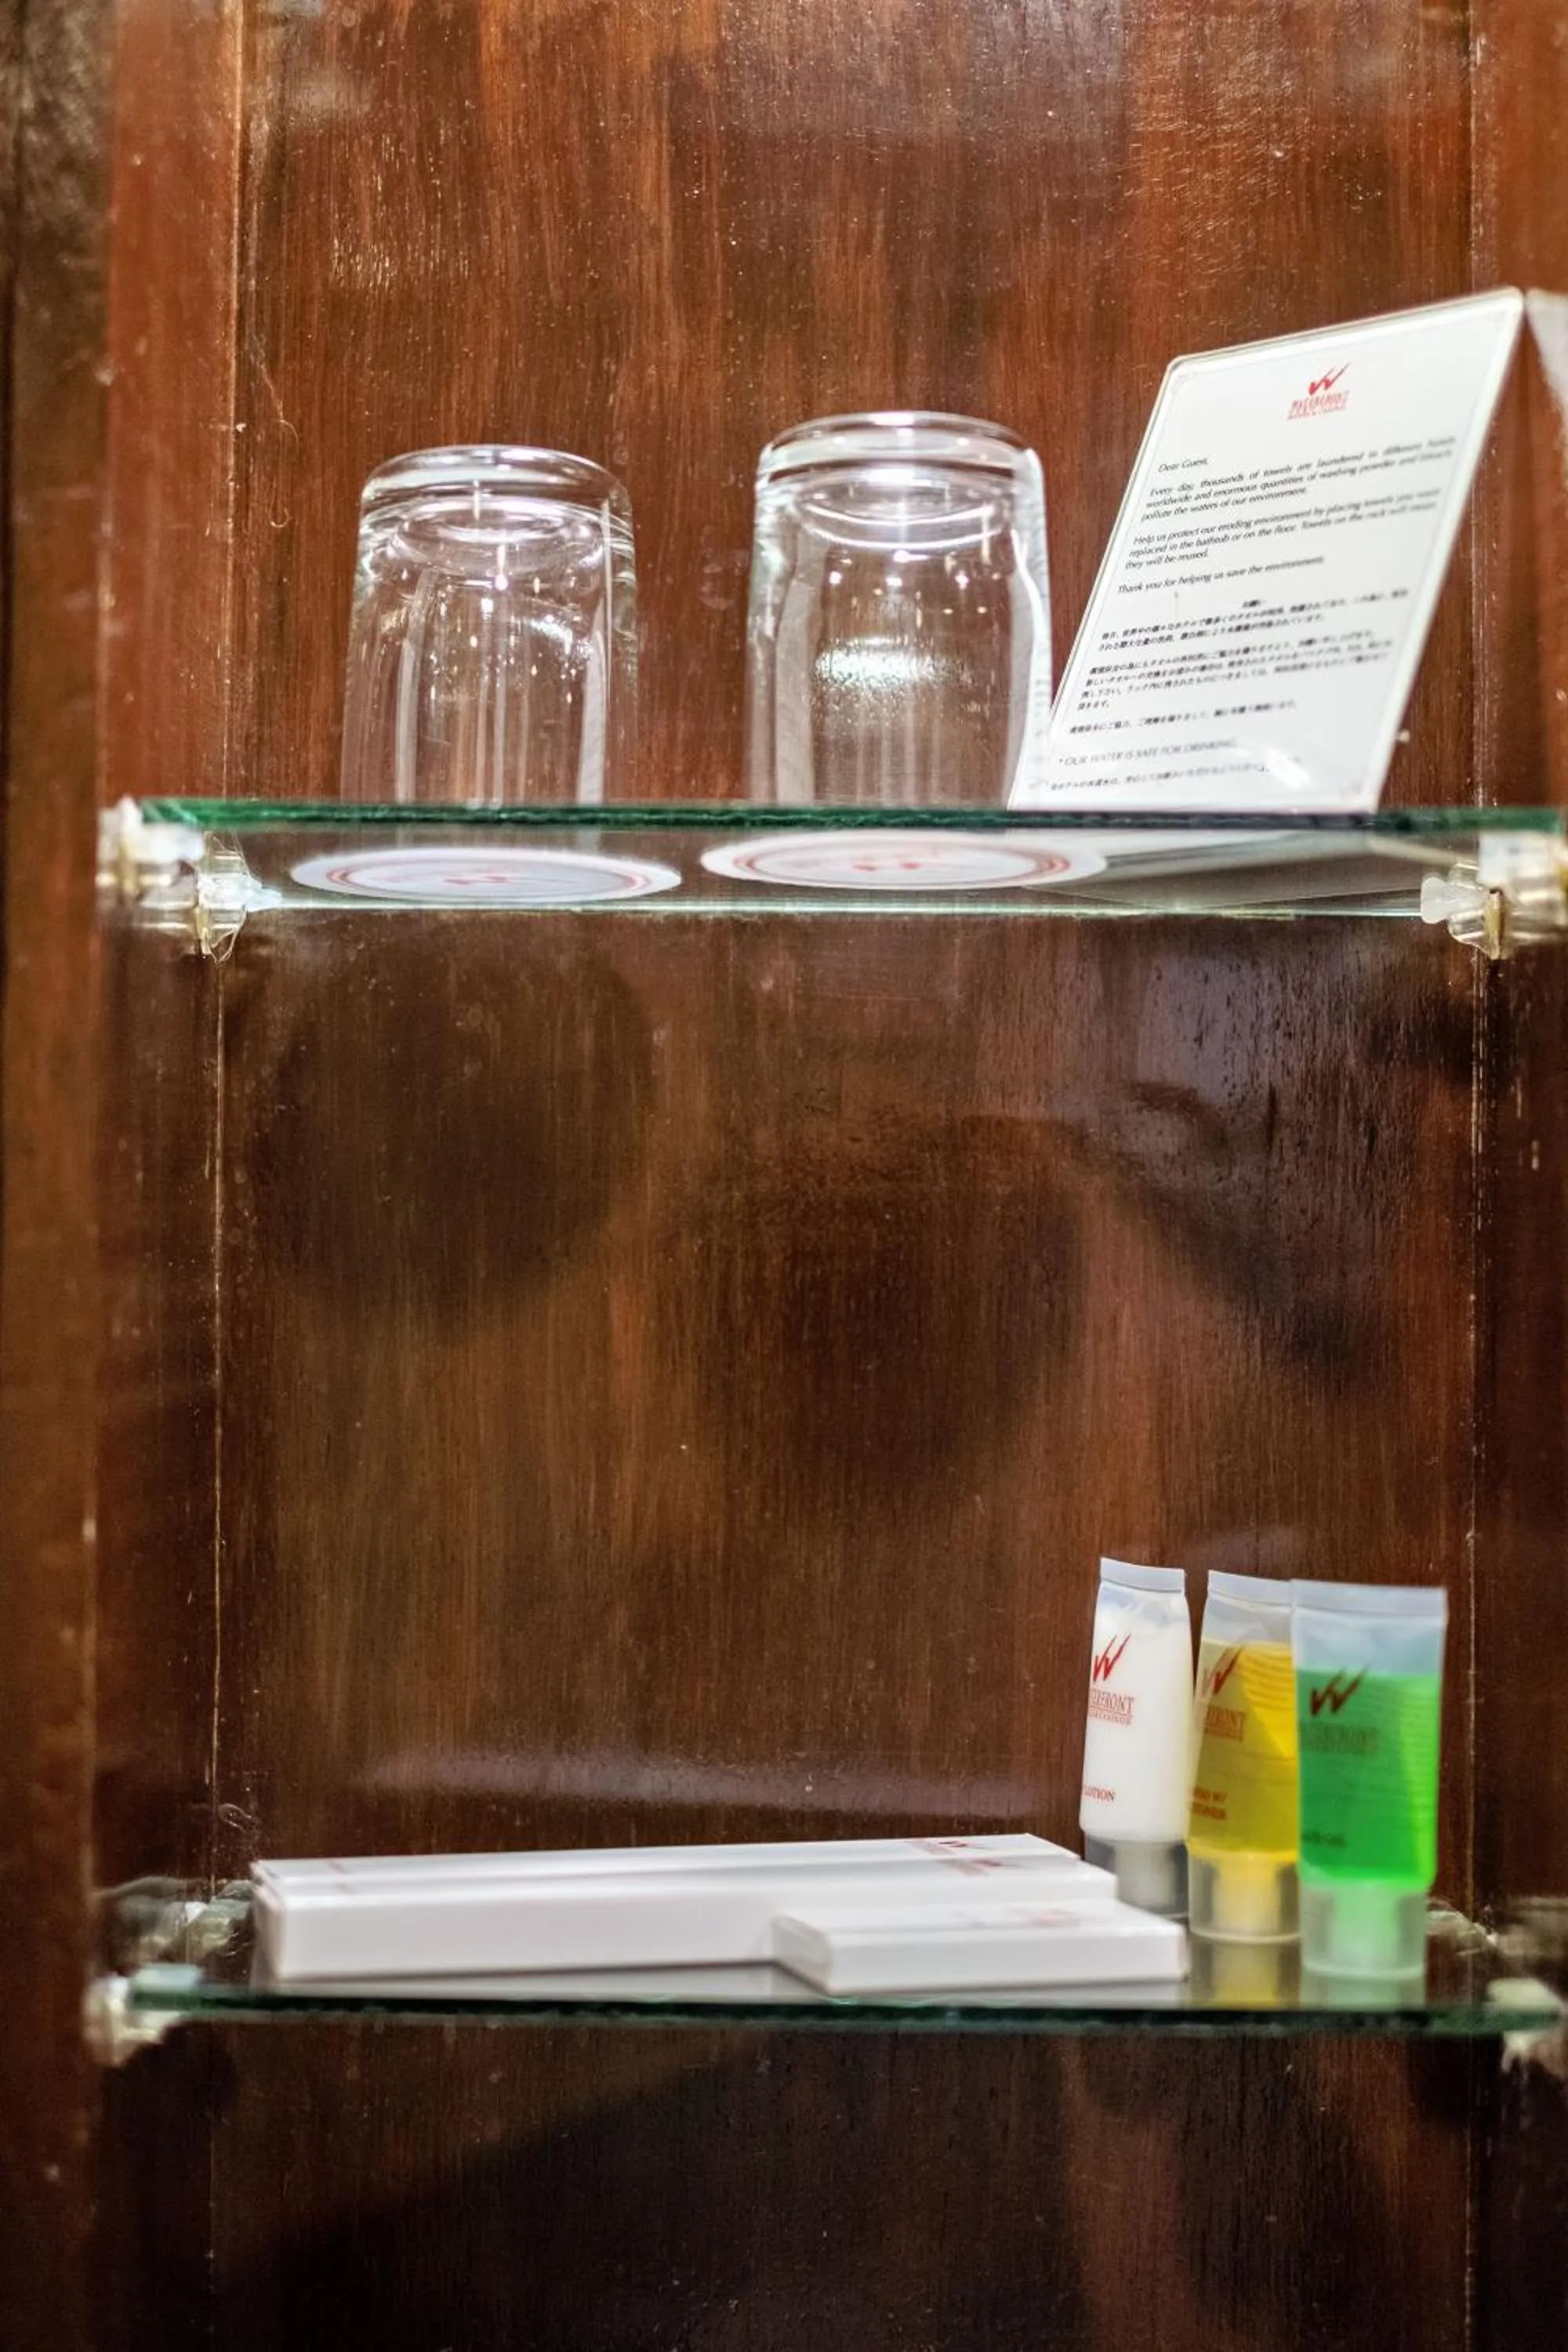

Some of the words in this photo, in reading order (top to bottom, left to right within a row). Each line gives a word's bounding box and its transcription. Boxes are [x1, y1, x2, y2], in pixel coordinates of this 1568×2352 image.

[1146, 493, 1192, 509] worldwide
[1195, 488, 1212, 501] and
[1214, 484, 1258, 497] enormous
[1260, 474, 1305, 490] quantities
[1307, 471, 1318, 481] of
[1319, 466, 1358, 480] washing
[1359, 459, 1395, 475] powder
[1399, 455, 1417, 466] and
[1150, 486, 1173, 497] Every
[1200, 473, 1244, 488] thousands
[1249, 470, 1260, 481] of
[1263, 464, 1294, 477] towels
[1297, 462, 1312, 471] are
[1317, 451, 1365, 469] laundered
[1369, 449, 1378, 459] in
[1383, 441, 1423, 457] different
[1158, 463, 1179, 473] Dear
[1133, 533, 1155, 546] Help
[1156, 532, 1166, 542] us
[1168, 527, 1200, 540] protect
[1200, 525, 1216, 535] our
[1218, 519, 1253, 533] eroding
[1254, 508, 1312, 526] environment
[1312, 505, 1323, 517] by
[1325, 502, 1361, 517] placing
[1363, 496, 1394, 508] towels
[1396, 493, 1414, 503] you
[1141, 508, 1173, 522] pollute
[1174, 504, 1189, 516] the
[1190, 501, 1218, 514] waters
[1220, 499, 1231, 508] of
[1232, 495, 1247, 506] our
[1128, 543, 1168, 558] replaced
[1169, 542, 1178, 552] in
[1179, 539, 1194, 550] the
[1196, 535, 1230, 548] bathtub
[1232, 533, 1242, 543] or
[1243, 531, 1255, 540] on
[1257, 527, 1272, 537] the
[1301, 517, 1333, 531] Towels
[1334, 515, 1346, 525] on
[1348, 512, 1363, 523] the
[1365, 509, 1385, 521] rack
[1389, 504, 1408, 515] will
[1124, 559, 1144, 571] they
[1145, 554, 1163, 567] will
[1164, 553, 1176, 564] be
[1117, 582, 1143, 595] Thank
[1145, 580, 1163, 591] you
[1163, 577, 1177, 590] for
[1178, 572, 1212, 586] helping
[1214, 570, 1225, 581] us
[1226, 567, 1247, 579] save
[1248, 564, 1263, 575] the
[1065, 754, 1087, 767] OUR
[1090, 750, 1124, 764] WATER
[1124, 750, 1134, 761] IS
[1136, 747, 1159, 760] SAFE
[1160, 744, 1182, 757] FOR
